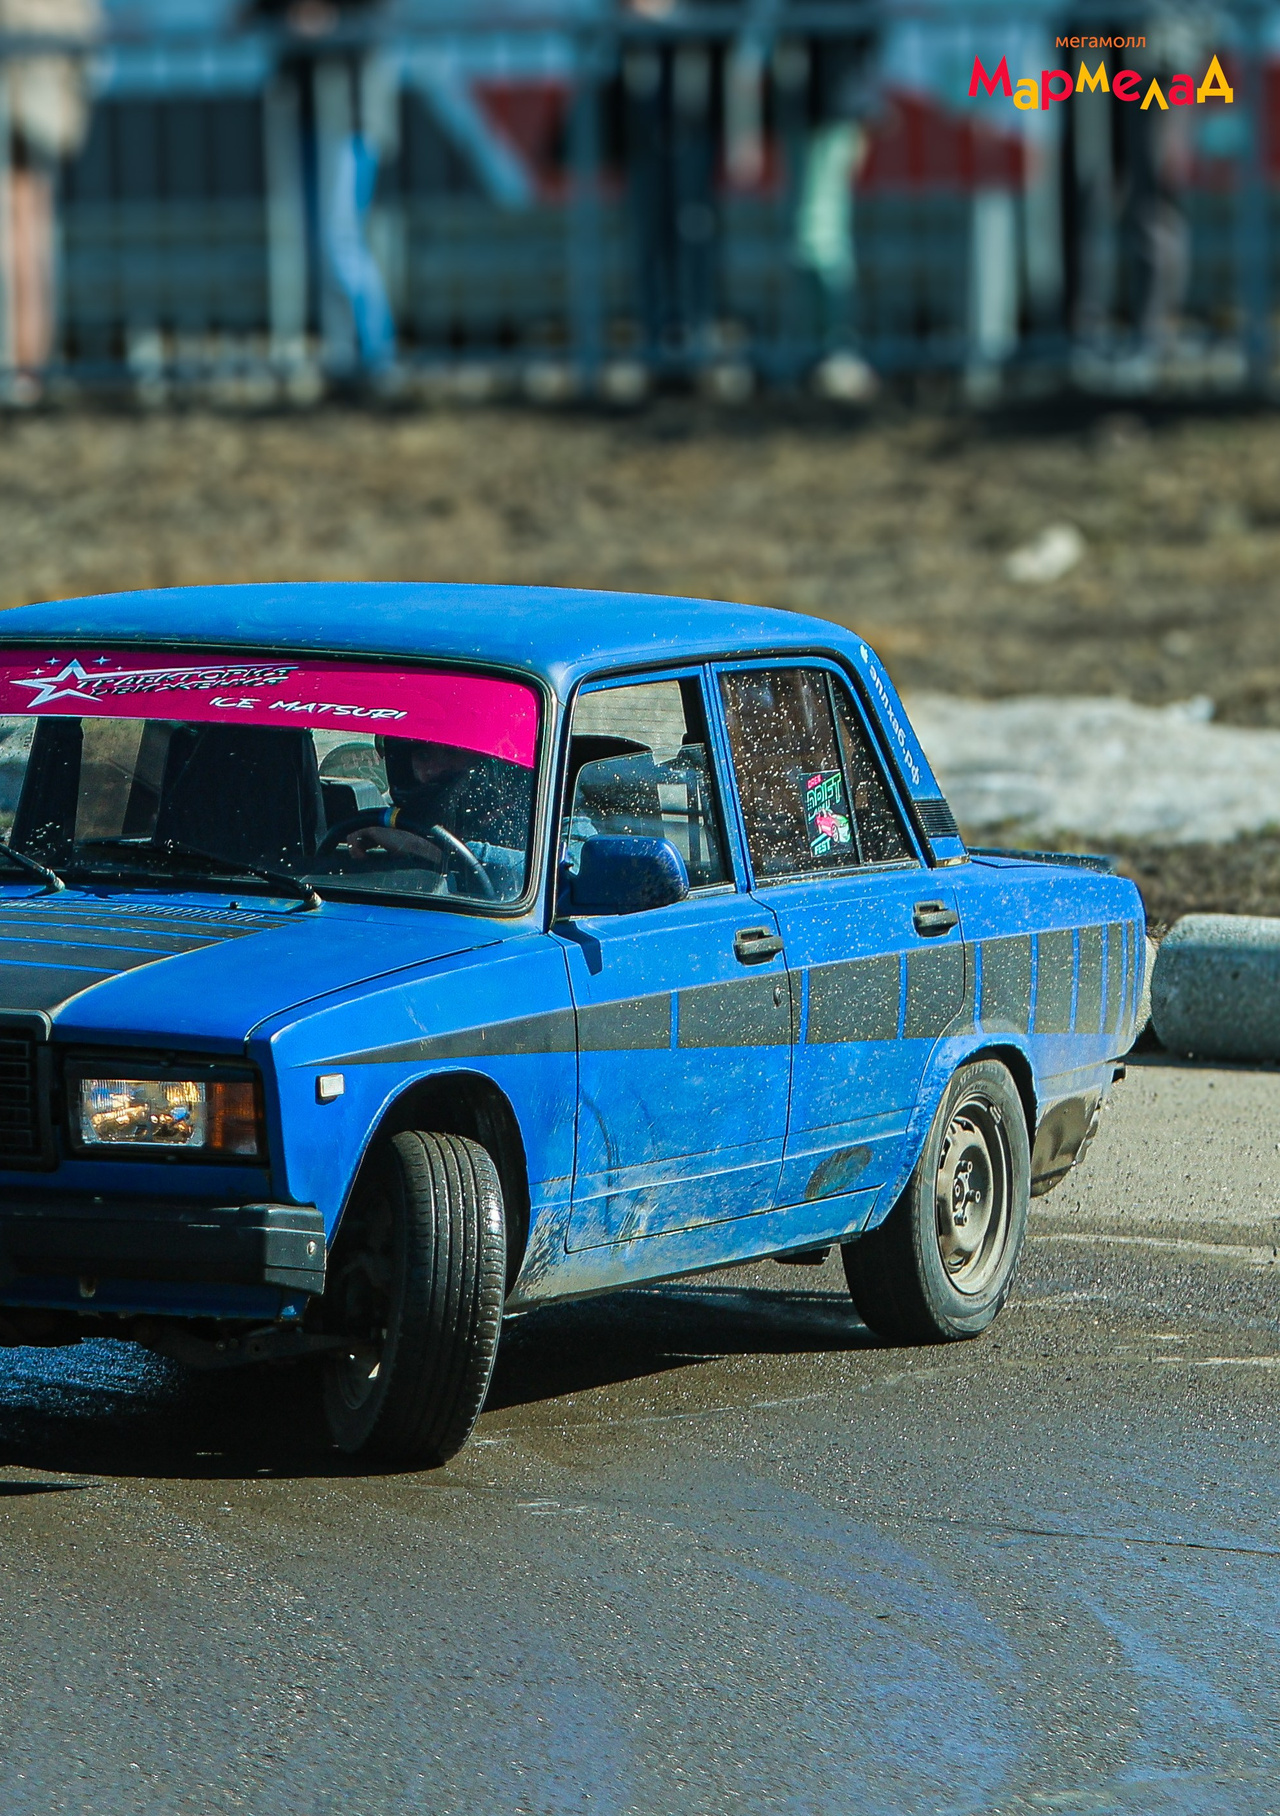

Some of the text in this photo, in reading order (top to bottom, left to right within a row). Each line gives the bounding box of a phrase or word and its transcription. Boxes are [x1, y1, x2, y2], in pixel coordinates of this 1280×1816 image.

[209, 697, 408, 720] ICE MATSURI
[814, 837, 831, 855] FEST
